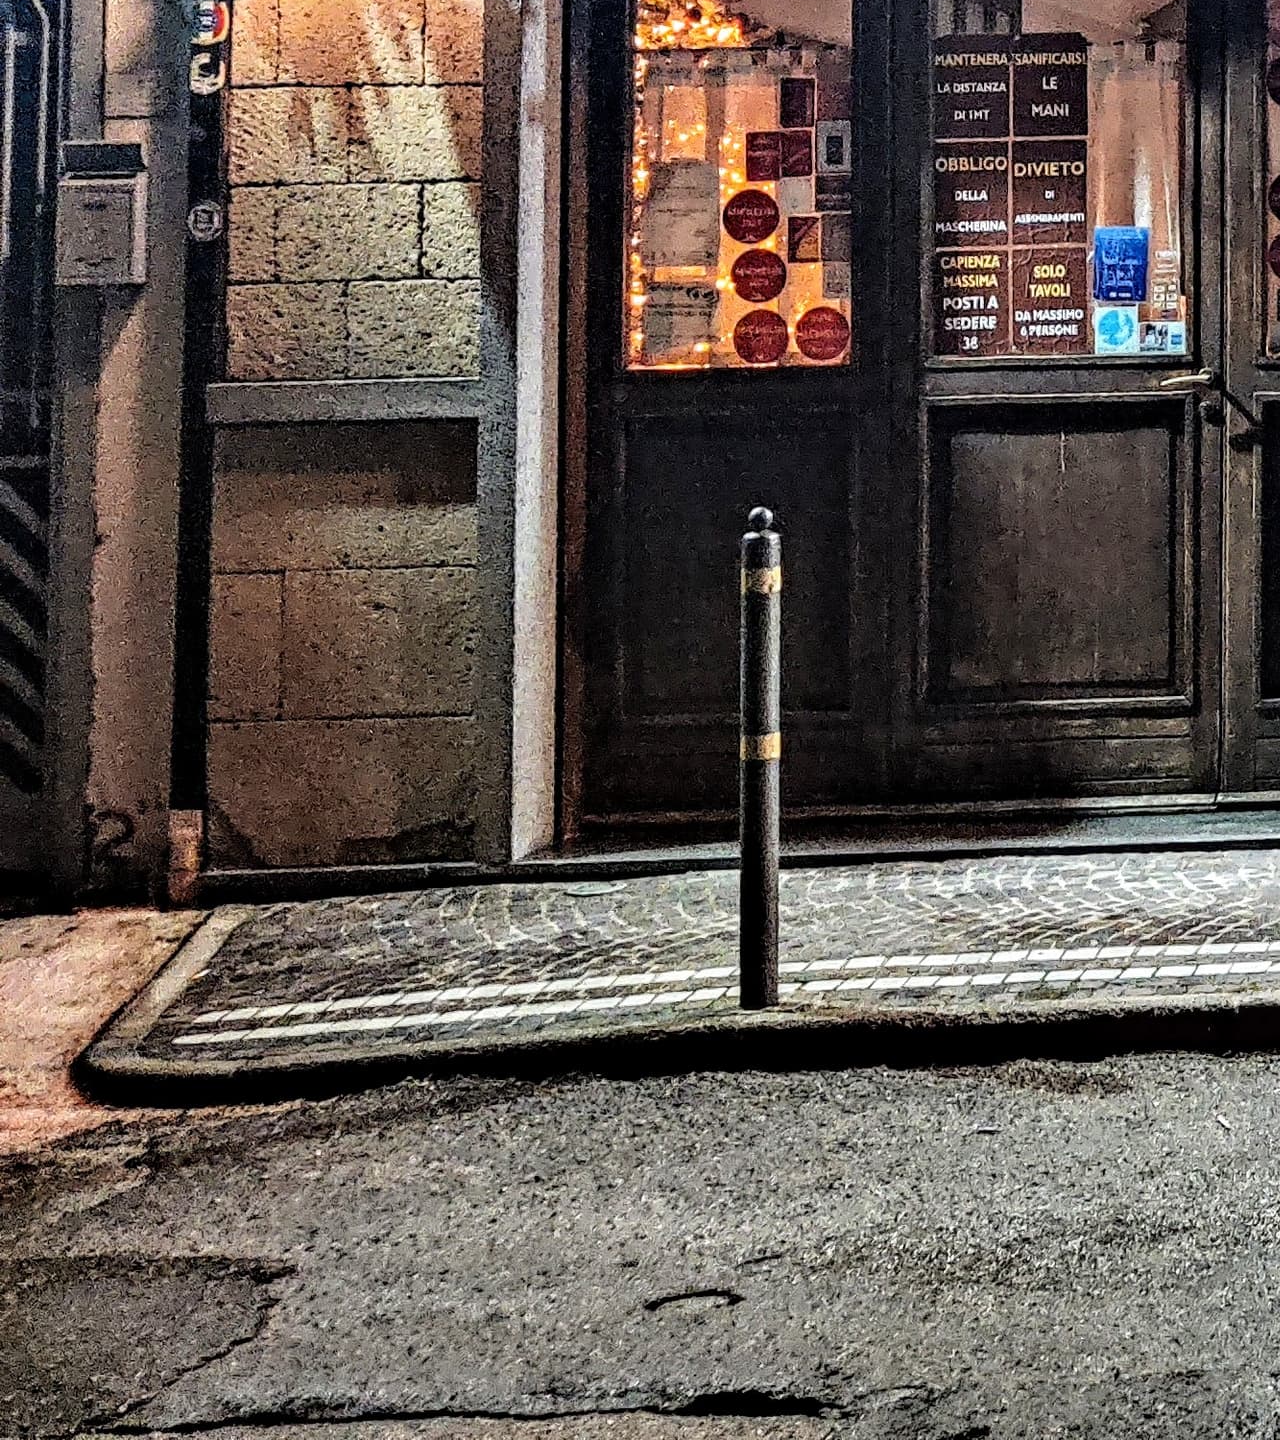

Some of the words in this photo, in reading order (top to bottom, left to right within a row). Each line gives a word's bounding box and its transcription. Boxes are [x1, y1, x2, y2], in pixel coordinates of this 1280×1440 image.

[937, 83, 950, 93] LA
[953, 82, 1007, 93] DISTANZA
[1042, 76, 1058, 90] LE
[954, 110, 965, 121] DI
[1031, 103, 1070, 118] MANI
[935, 156, 1008, 172] OBBLIGO
[1014, 161, 1085, 177] DIVIETO
[954, 190, 988, 201] DELLA
[1045, 190, 1055, 200] DI
[935, 220, 1008, 233] MASCHERINA
[941, 255, 1001, 269] CAPIENZA
[1033, 265, 1066, 278] SOLO
[944, 274, 999, 287] MASSIMA
[1029, 284, 1071, 297] TAVOLI
[943, 296, 985, 310] POSTI
[987, 295, 999, 309] A
[1014, 311, 1032, 322] DA
[1033, 309, 1084, 321] MASSIMO
[945, 316, 998, 330] SEDERE
